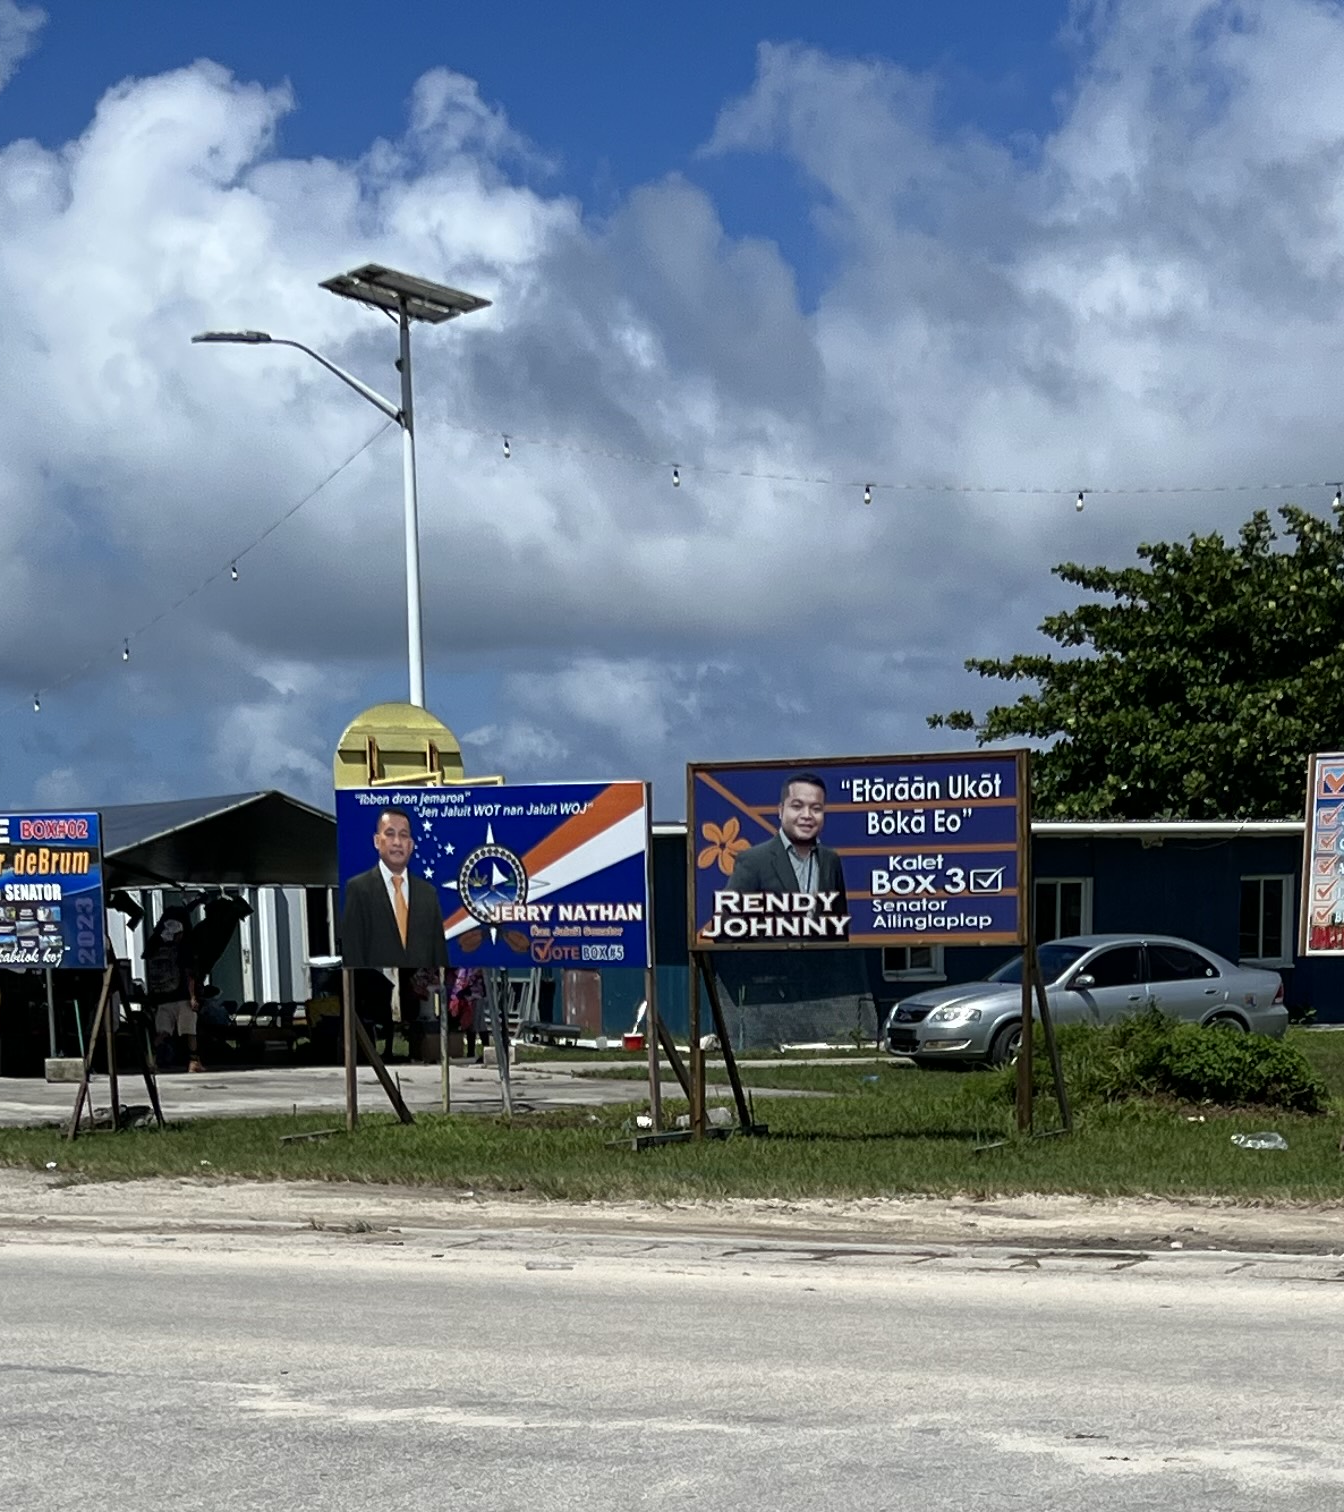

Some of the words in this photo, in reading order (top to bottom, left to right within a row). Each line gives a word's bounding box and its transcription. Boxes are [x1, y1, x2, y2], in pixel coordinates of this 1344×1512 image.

[473, 803, 502, 816] WOT
[14, 848, 89, 876] deBrum
[889, 854, 944, 871] Kalet
[945, 868, 966, 894] 3
[5, 883, 62, 901] SENATOR
[714, 890, 841, 915] RENDY
[872, 898, 947, 913] Senator
[491, 904, 554, 922] JERRY
[559, 903, 643, 921] NATHAN
[75, 897, 96, 965] 2023
[702, 914, 851, 938] JOHNNY
[873, 913, 992, 931] Ailinglaplap
[581, 945, 607, 960] BOX
